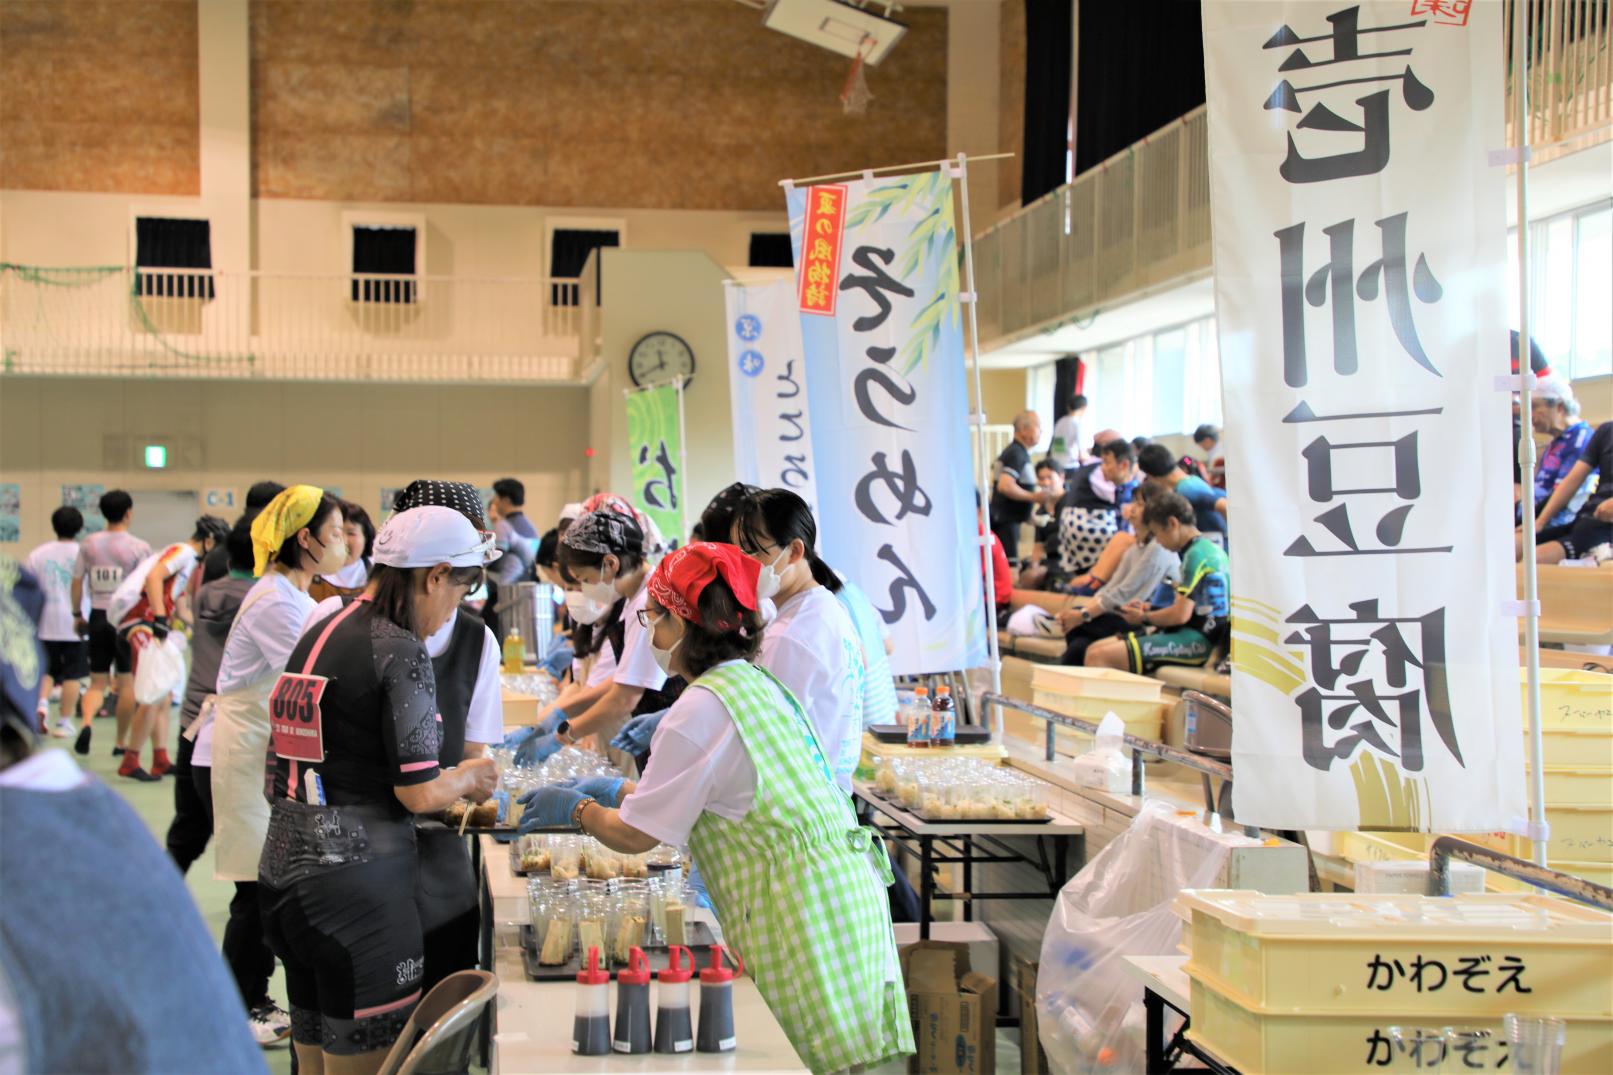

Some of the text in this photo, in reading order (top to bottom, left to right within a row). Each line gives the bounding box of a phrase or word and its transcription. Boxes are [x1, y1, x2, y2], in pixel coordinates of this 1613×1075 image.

[273, 678, 316, 723] 805
[1366, 953, 1533, 993] かわぞえ
